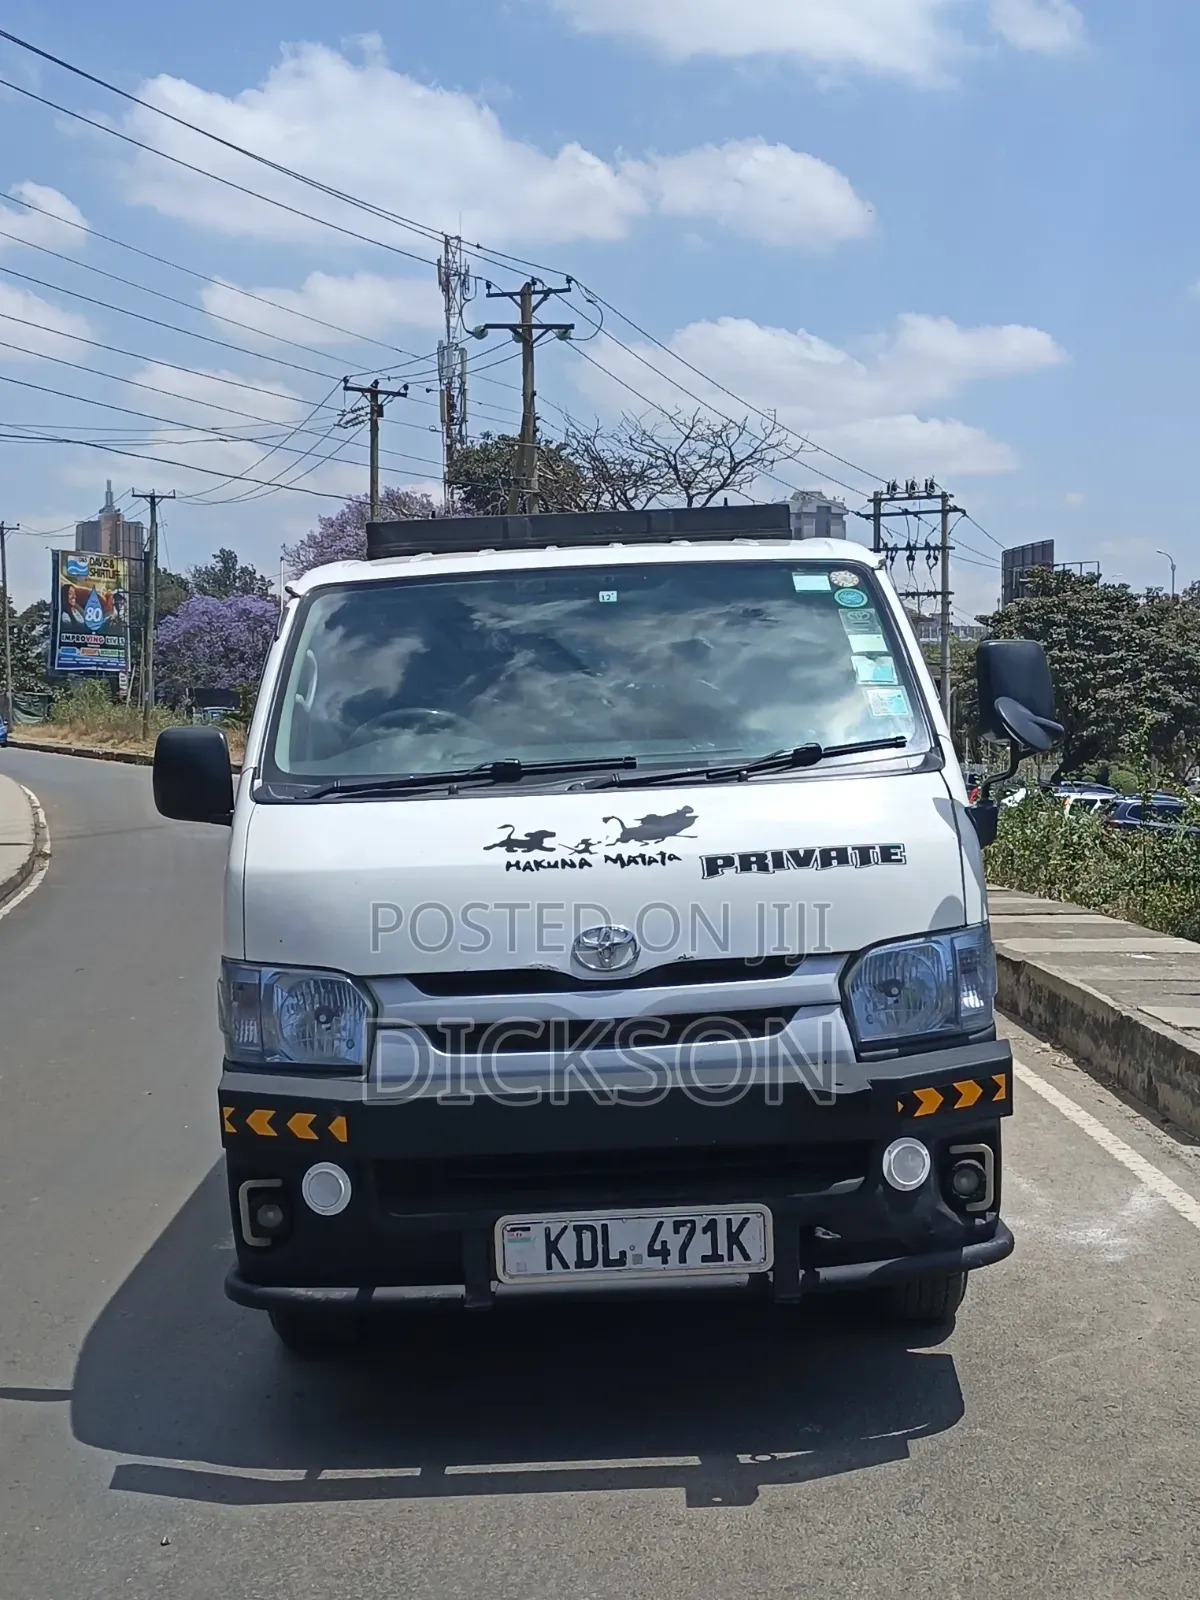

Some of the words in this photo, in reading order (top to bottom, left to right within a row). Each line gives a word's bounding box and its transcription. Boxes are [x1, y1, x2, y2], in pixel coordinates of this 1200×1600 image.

[85, 607, 102, 622] 80
[61, 633, 105, 644] IMPROVING
[105, 636, 125, 646] LIVS
[505, 857, 593, 872] HAKUNA
[699, 843, 907, 880] PRIVATE
[544, 1222, 627, 1270] KDL
[646, 1216, 752, 1265] 471K
